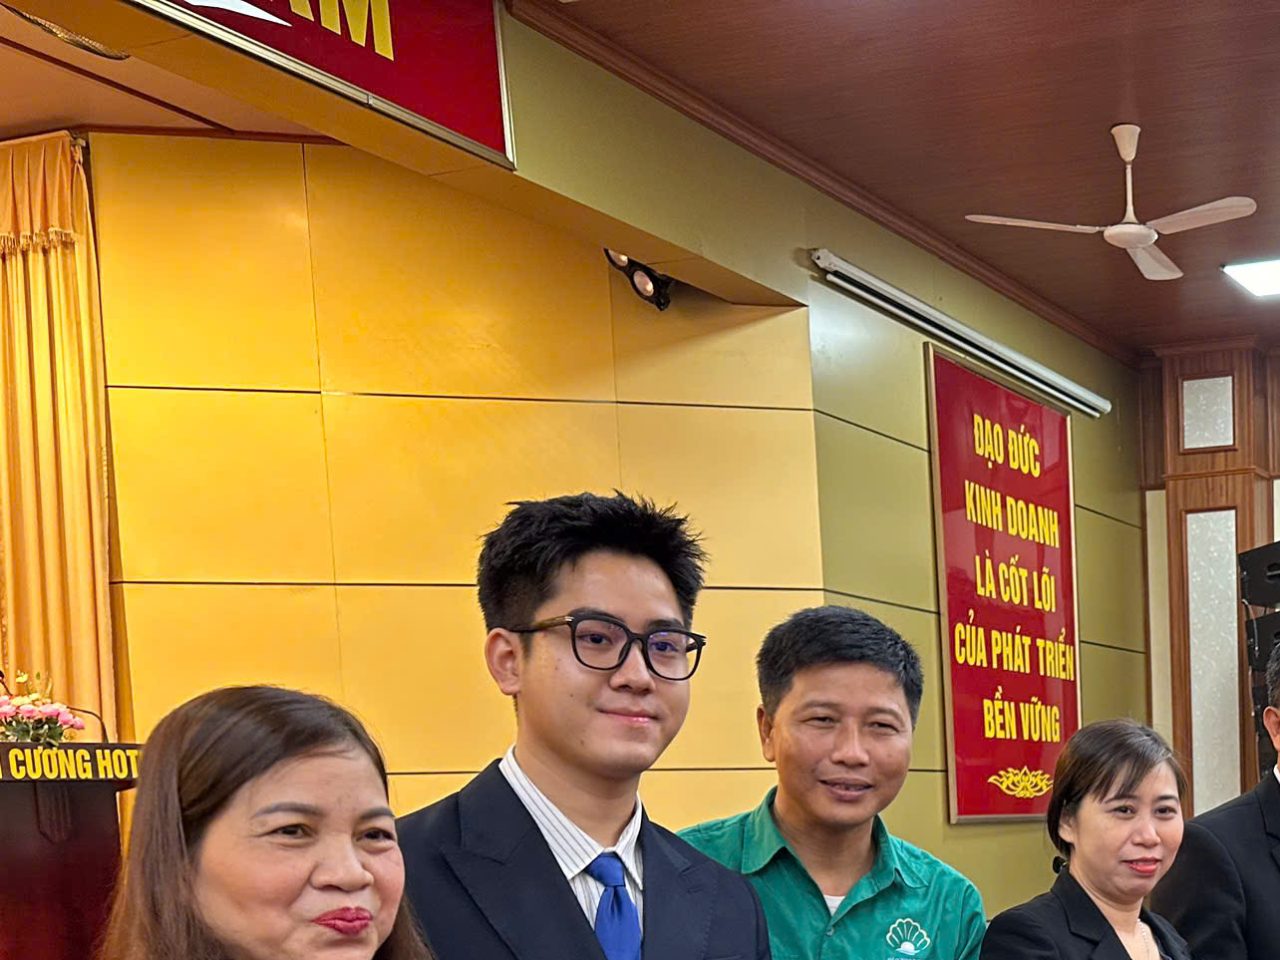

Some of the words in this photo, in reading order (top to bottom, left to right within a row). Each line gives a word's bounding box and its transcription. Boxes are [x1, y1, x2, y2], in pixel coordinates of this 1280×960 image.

[973, 413, 1005, 469] ĐẠO
[1008, 424, 1041, 478] ĐỨC
[964, 479, 1003, 532] KINH
[1006, 495, 1060, 549] DOANH
[975, 549, 997, 599] LÀ
[998, 554, 1029, 607] CỐT
[1032, 566, 1056, 613] LÕI
[954, 608, 988, 668] CỦA
[990, 625, 1031, 674] PHÁT
[1036, 627, 1075, 681] TRIỂN
[983, 685, 1018, 740] BỀN
[1019, 696, 1061, 743] VỮNG
[8, 746, 93, 780] CƯƠNG
[95, 749, 139, 779] HOT
